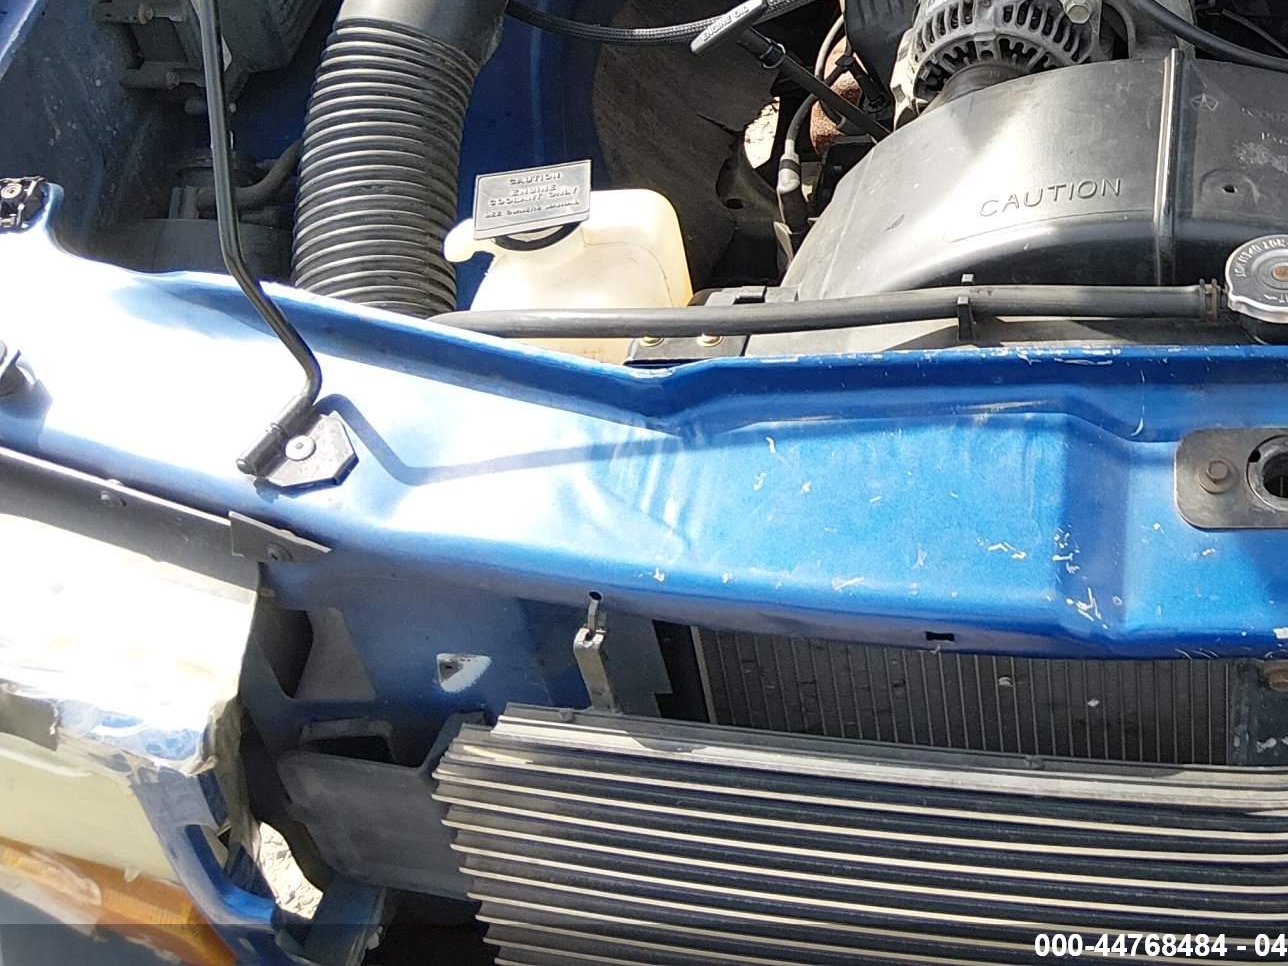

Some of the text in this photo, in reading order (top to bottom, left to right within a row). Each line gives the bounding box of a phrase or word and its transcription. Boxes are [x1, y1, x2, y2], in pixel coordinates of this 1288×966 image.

[702, 5, 749, 42] ENGINE OIL
[509, 172, 562, 186] CAUTION
[489, 186, 579, 207] COOLANT ONLY
[511, 184, 558, 197] ENGINE
[978, 177, 1122, 218] CAUTION
